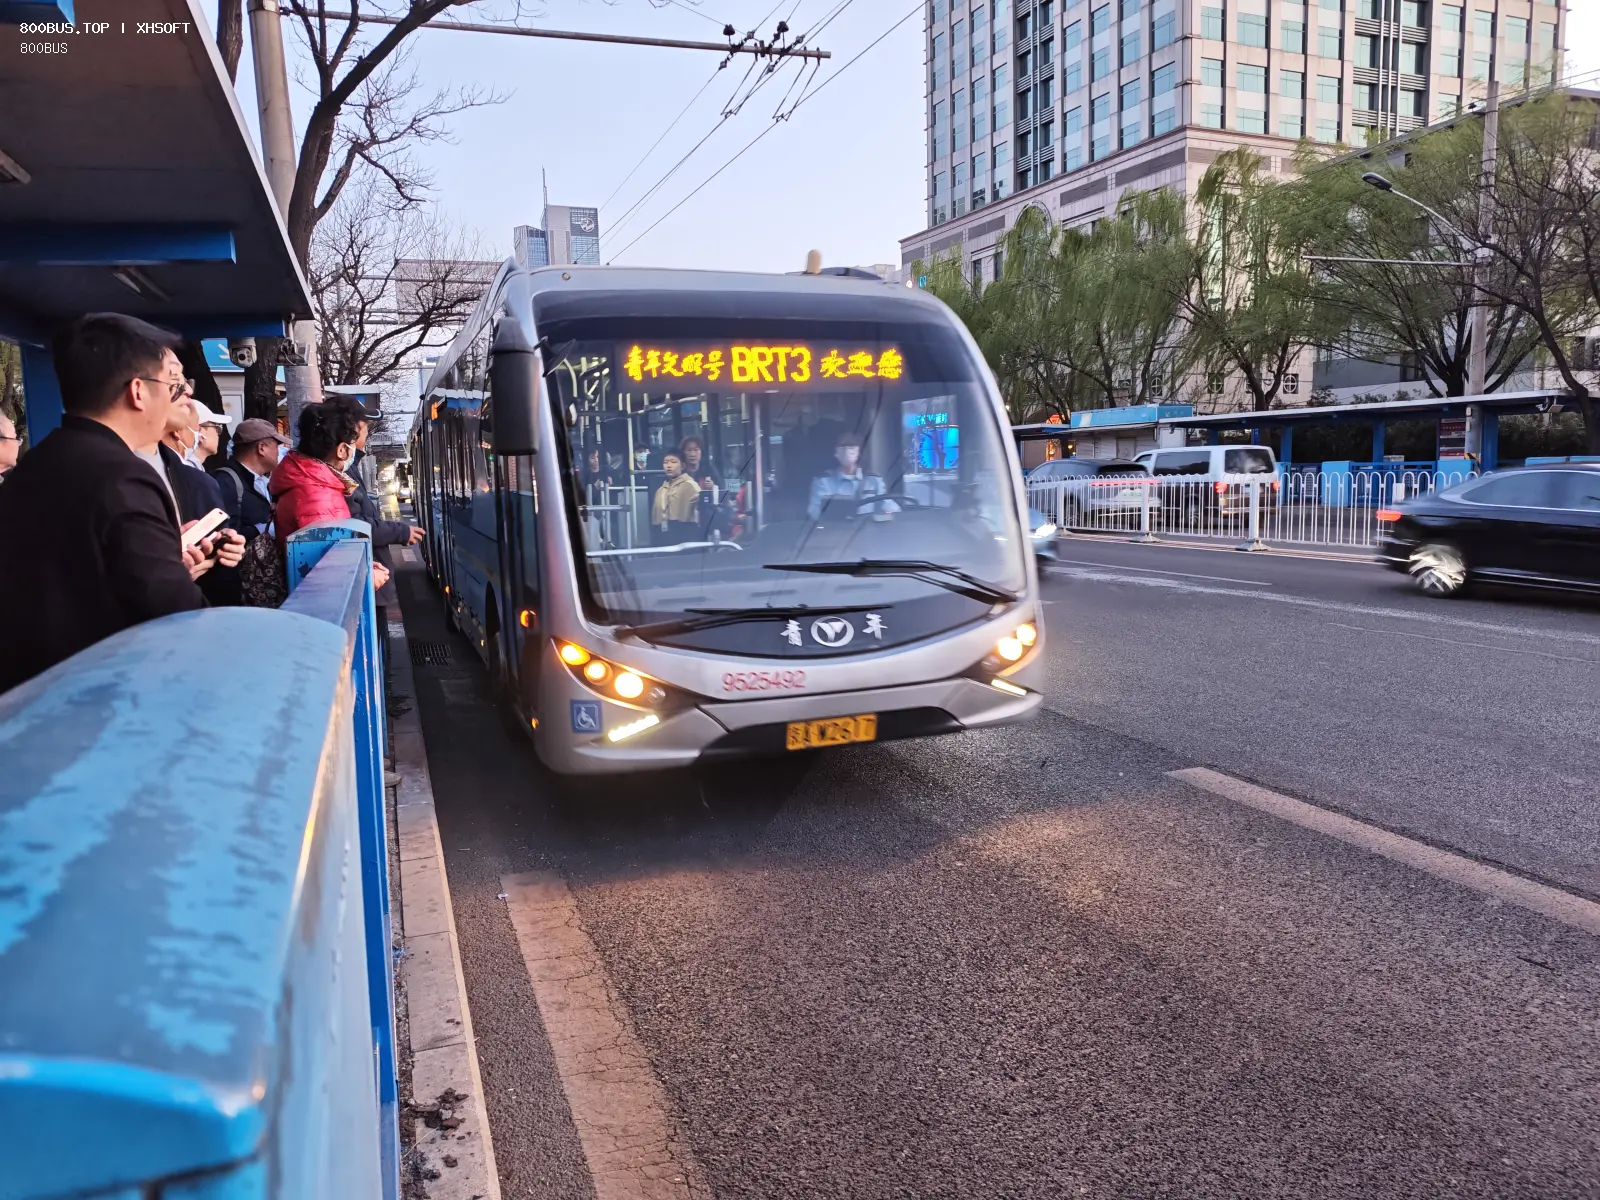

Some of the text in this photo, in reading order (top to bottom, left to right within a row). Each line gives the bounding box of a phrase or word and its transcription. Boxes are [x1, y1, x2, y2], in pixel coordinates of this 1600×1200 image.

[623, 344, 904, 383] 青年文明号 BRT3 欢迎您
[780, 612, 888, 647] 青 年
[722, 670, 807, 692] 9525492
